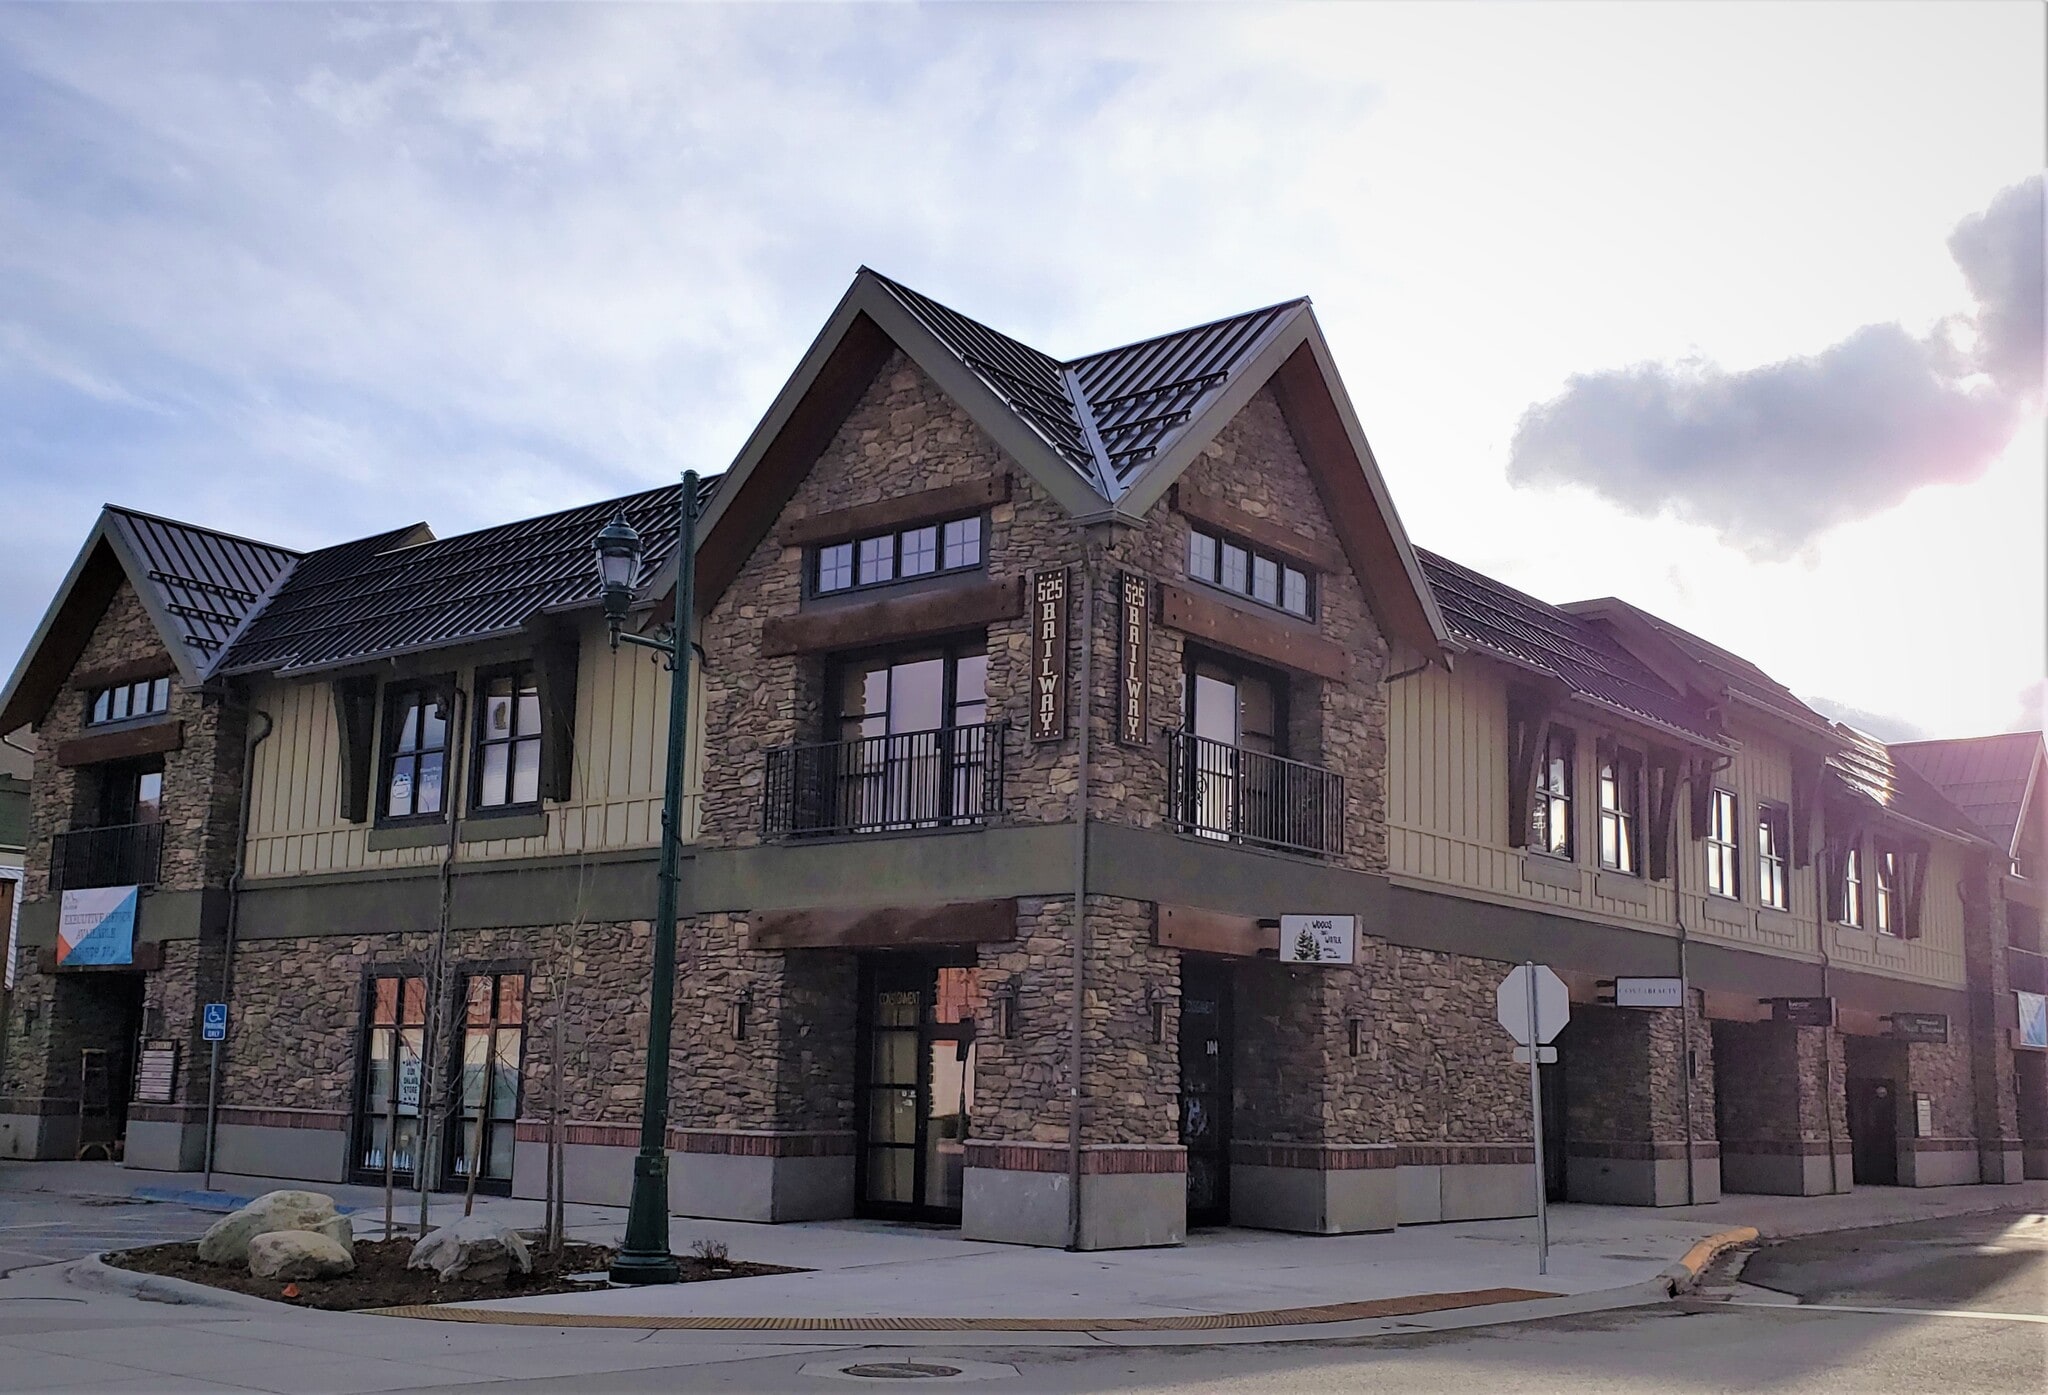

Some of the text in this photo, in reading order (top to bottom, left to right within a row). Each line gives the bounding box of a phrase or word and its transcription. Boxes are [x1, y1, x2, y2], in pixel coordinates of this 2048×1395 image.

[1038, 579, 1063, 602] 525
[1125, 583, 1145, 607] 525
[1038, 602, 1059, 731] RAILWAY
[1126, 605, 1142, 735] RAILWAY
[1312, 919, 1333, 929] WOODS
[1206, 1040, 1218, 1055] 104
